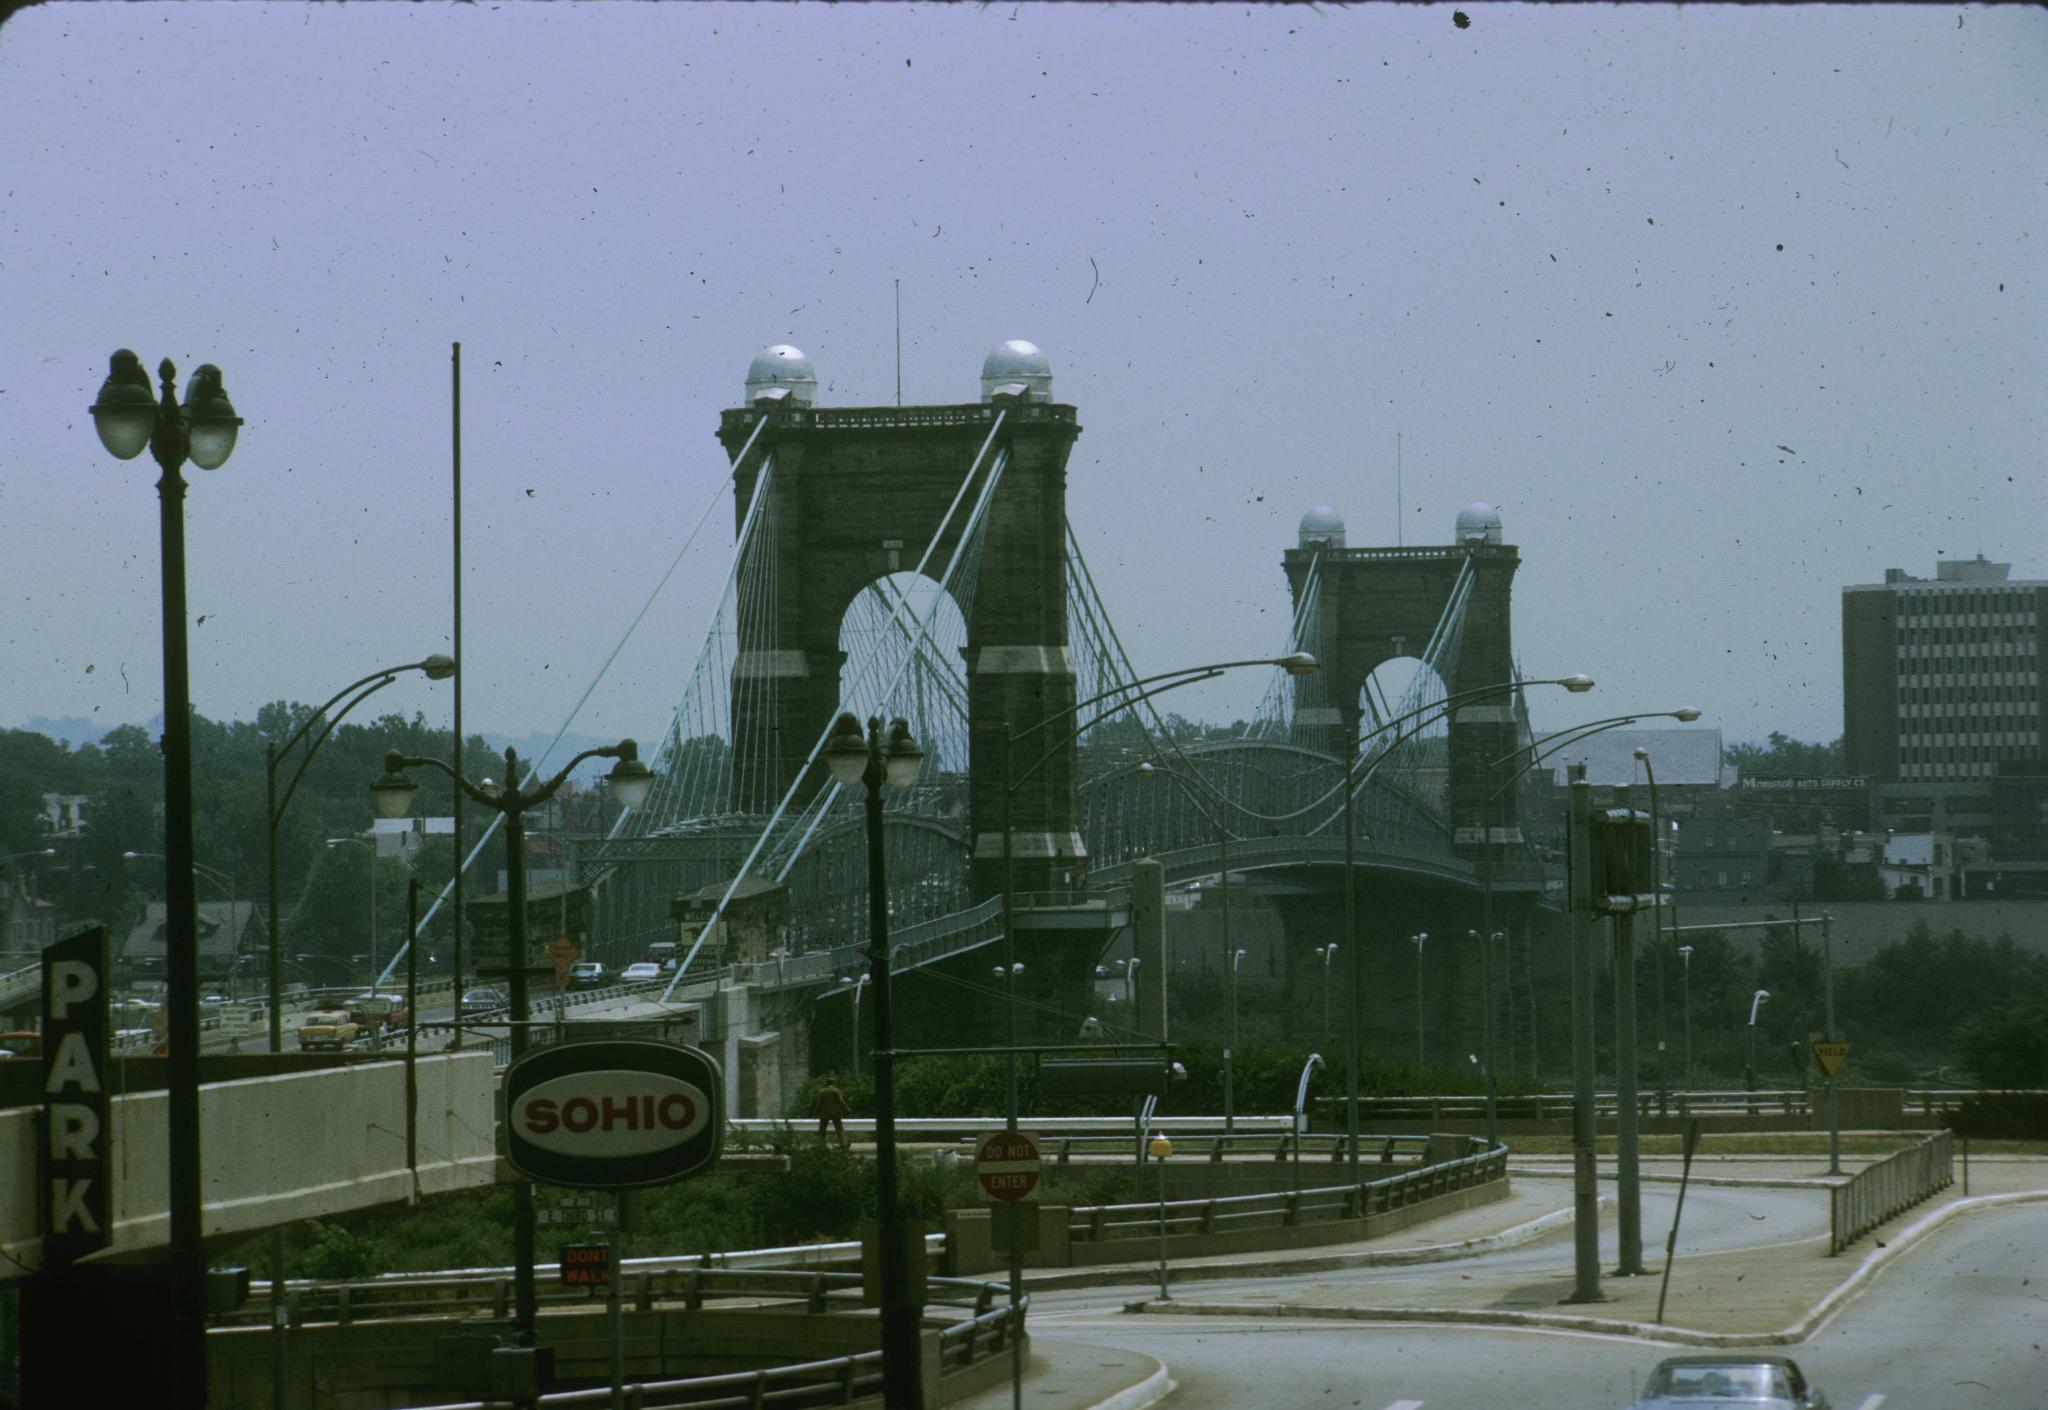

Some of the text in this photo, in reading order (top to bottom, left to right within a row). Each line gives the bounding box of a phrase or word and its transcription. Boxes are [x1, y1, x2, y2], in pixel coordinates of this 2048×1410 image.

[1818, 1048, 1845, 1056] YIELD
[45, 960, 101, 1232] PARK
[525, 1094, 696, 1134] SOHIO
[987, 1144, 1030, 1158] DO NOT
[992, 1175, 1028, 1188] ENTER
[561, 1209, 586, 1218] THIRD
